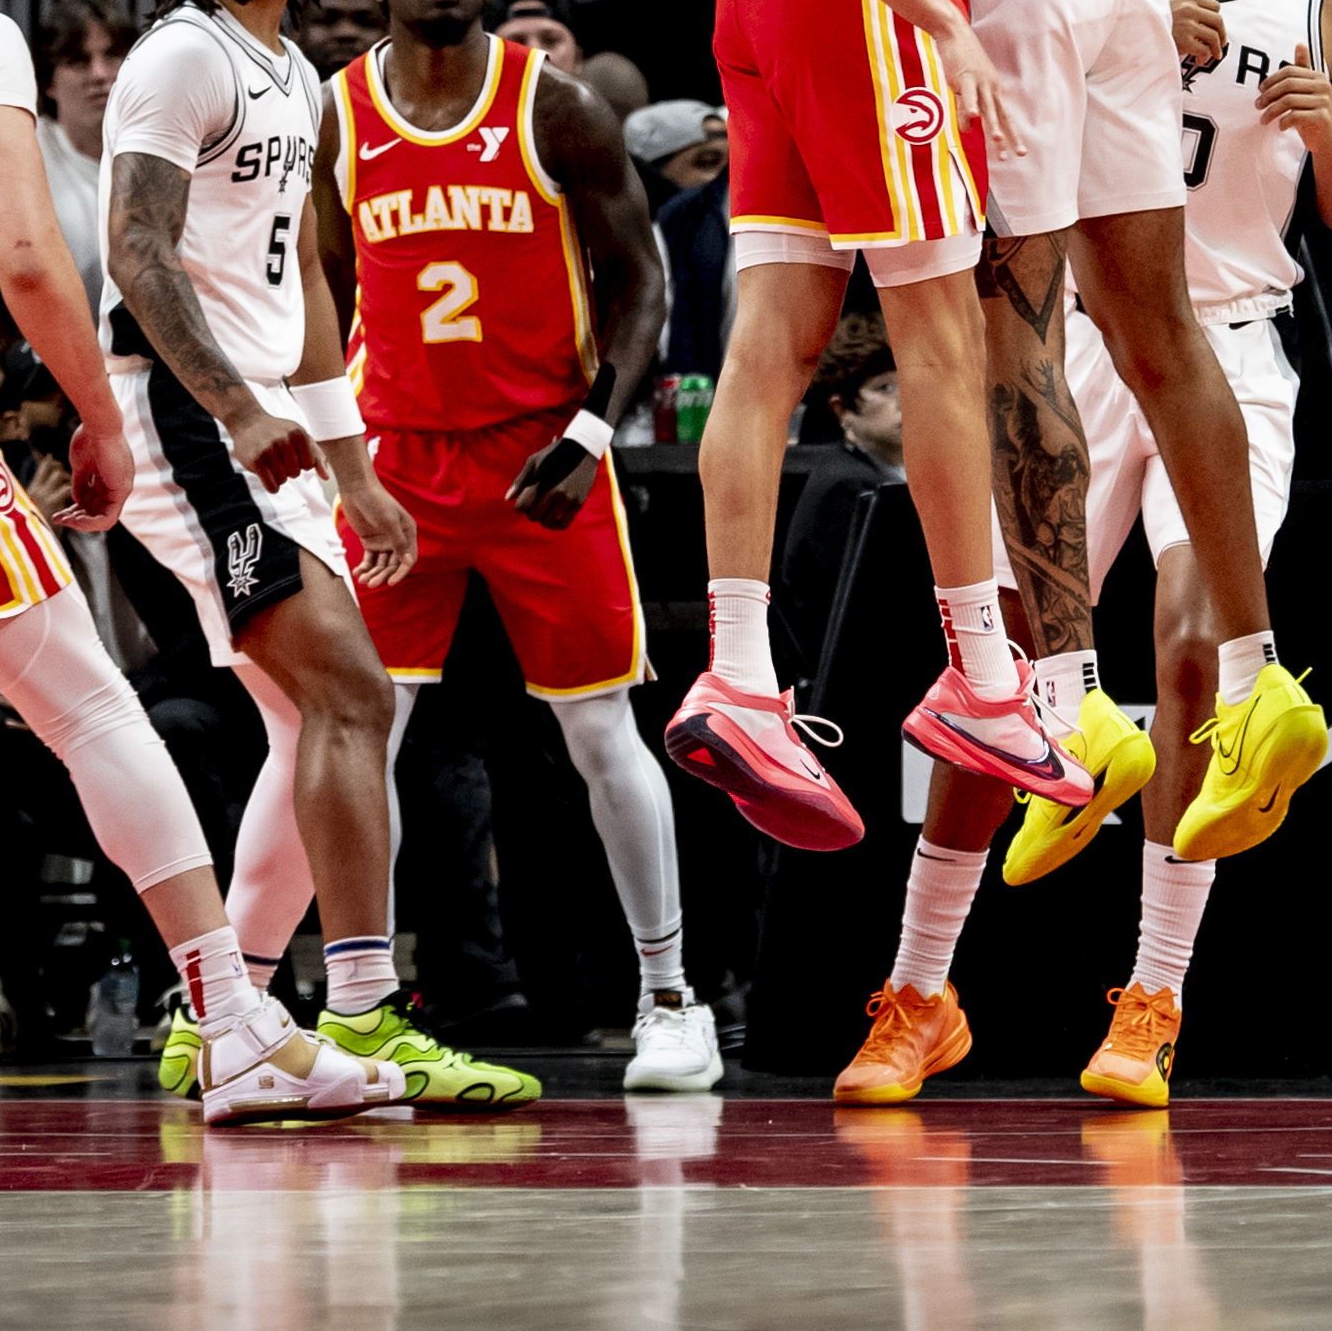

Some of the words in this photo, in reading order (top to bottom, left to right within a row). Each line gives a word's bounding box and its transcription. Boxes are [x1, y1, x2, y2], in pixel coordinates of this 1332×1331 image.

[265, 213, 292, 289] 5
[358, 185, 535, 244] ATLANTA
[417, 260, 483, 345] 2
